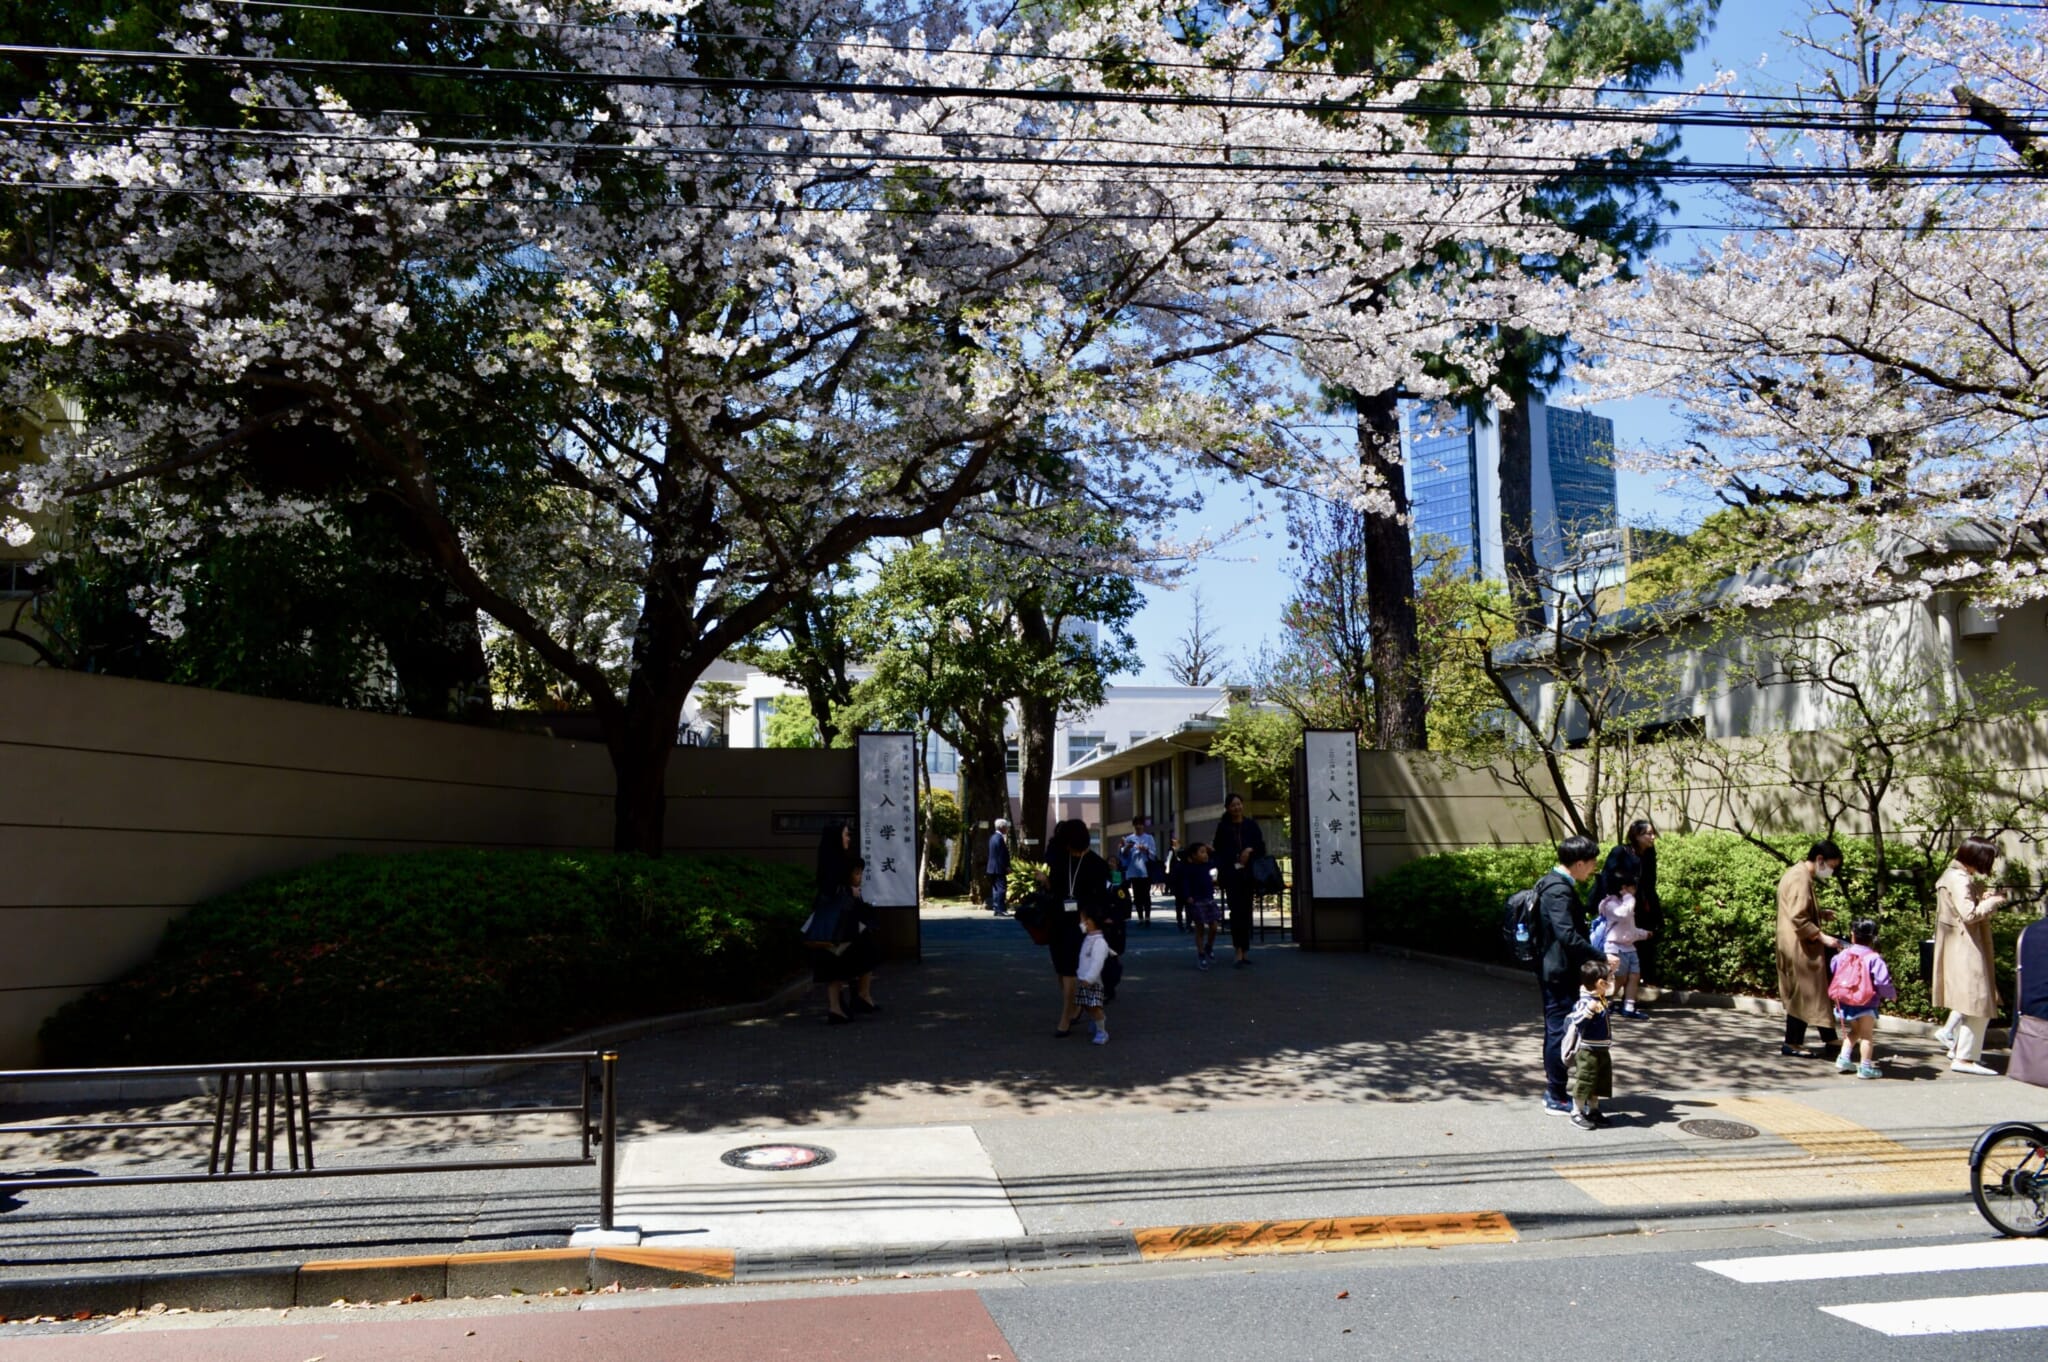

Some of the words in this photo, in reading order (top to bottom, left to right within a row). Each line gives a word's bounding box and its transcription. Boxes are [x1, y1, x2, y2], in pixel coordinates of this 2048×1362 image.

[879, 793, 897, 873] 入学式
[1326, 788, 1345, 866] 入学式
